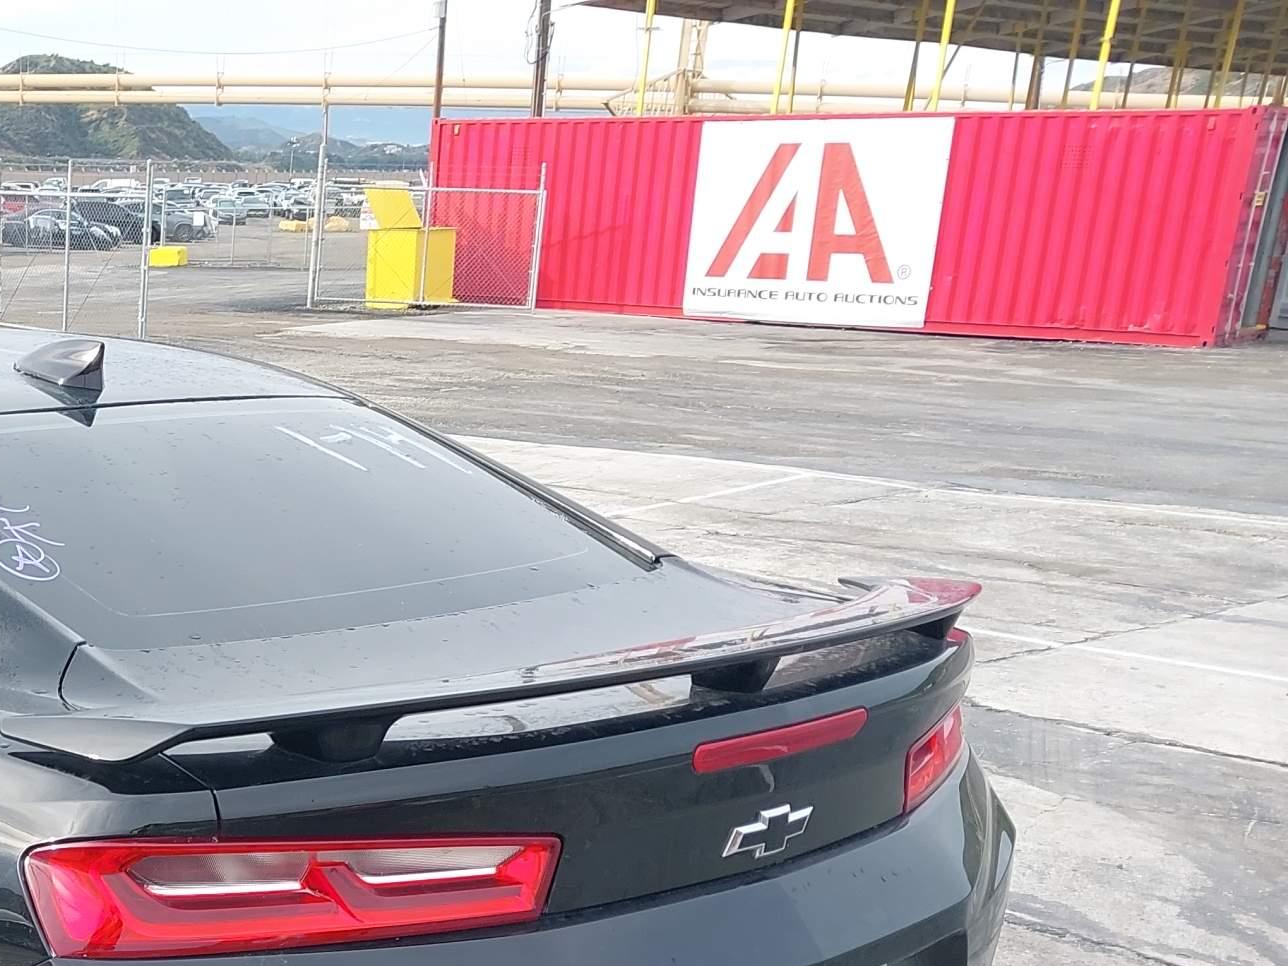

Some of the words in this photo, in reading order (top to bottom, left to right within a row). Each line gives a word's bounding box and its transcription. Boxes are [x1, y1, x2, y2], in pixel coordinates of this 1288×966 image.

[692, 287, 779, 300] INSURANCE
[784, 291, 829, 302] AUTO
[833, 293, 919, 306] AUCTIONS
